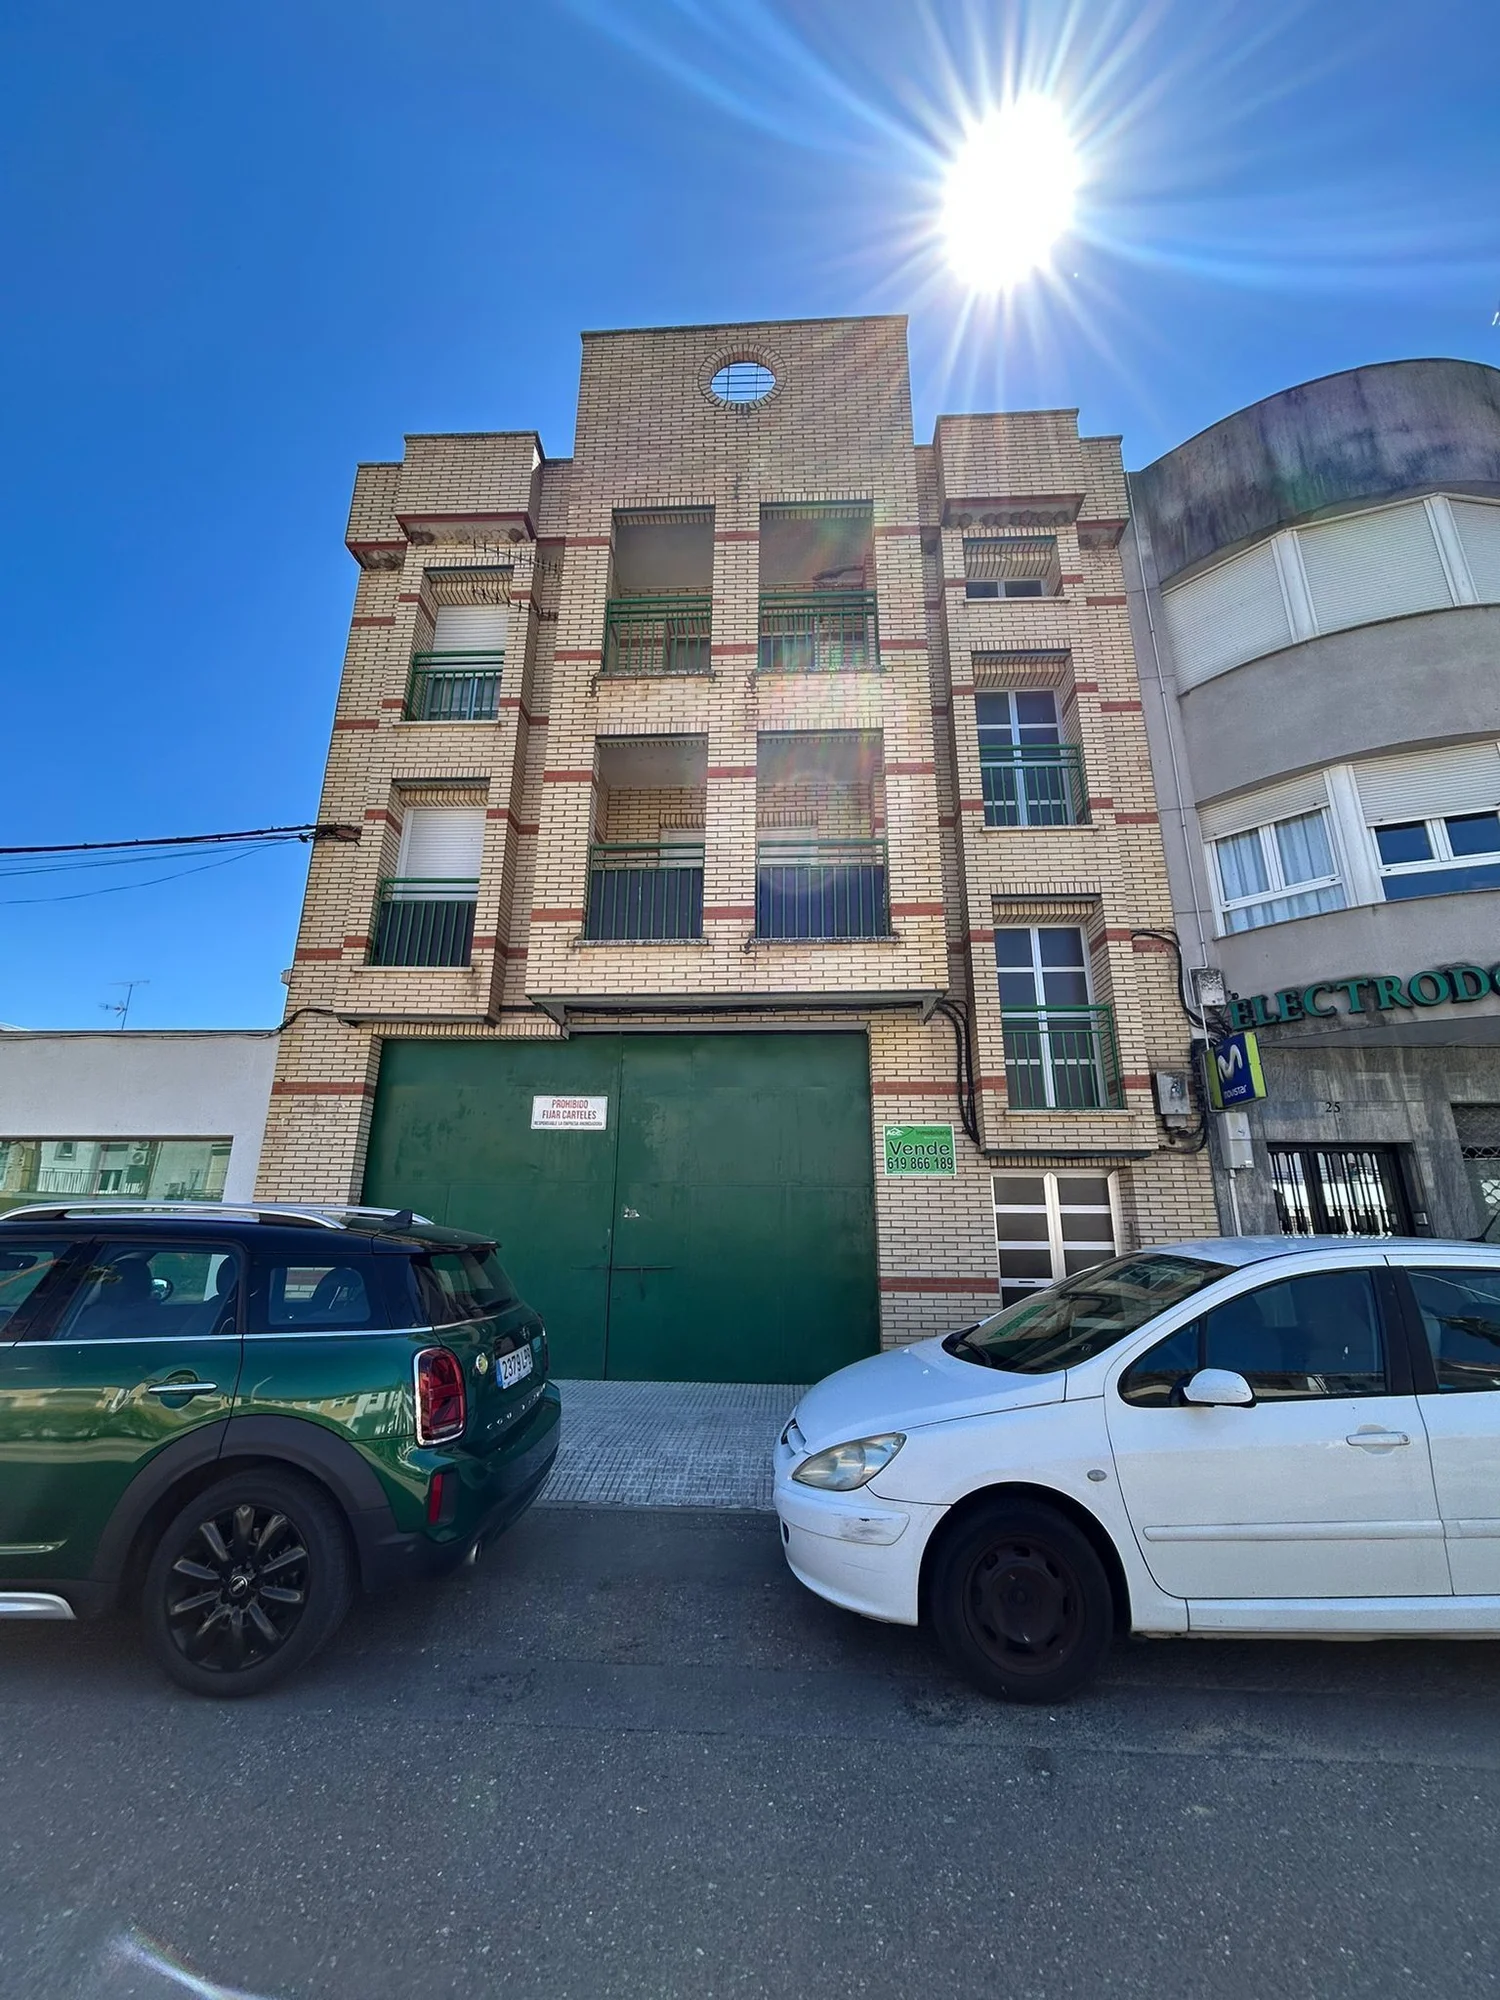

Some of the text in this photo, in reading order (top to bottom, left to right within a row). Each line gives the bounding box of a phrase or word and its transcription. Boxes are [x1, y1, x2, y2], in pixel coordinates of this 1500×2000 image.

[1228, 964, 1500, 1031] ELECTROD
[1223, 1084, 1247, 1099] movistar
[552, 1099, 589, 1109] PROHIBIDO
[1325, 1101, 1340, 1113] 25
[542, 1109, 597, 1120] FIJAR CARTELES
[889, 1141, 950, 1155] Vende
[887, 1157, 953, 1169] 619 866 189
[502, 1353, 521, 1380] 2379
